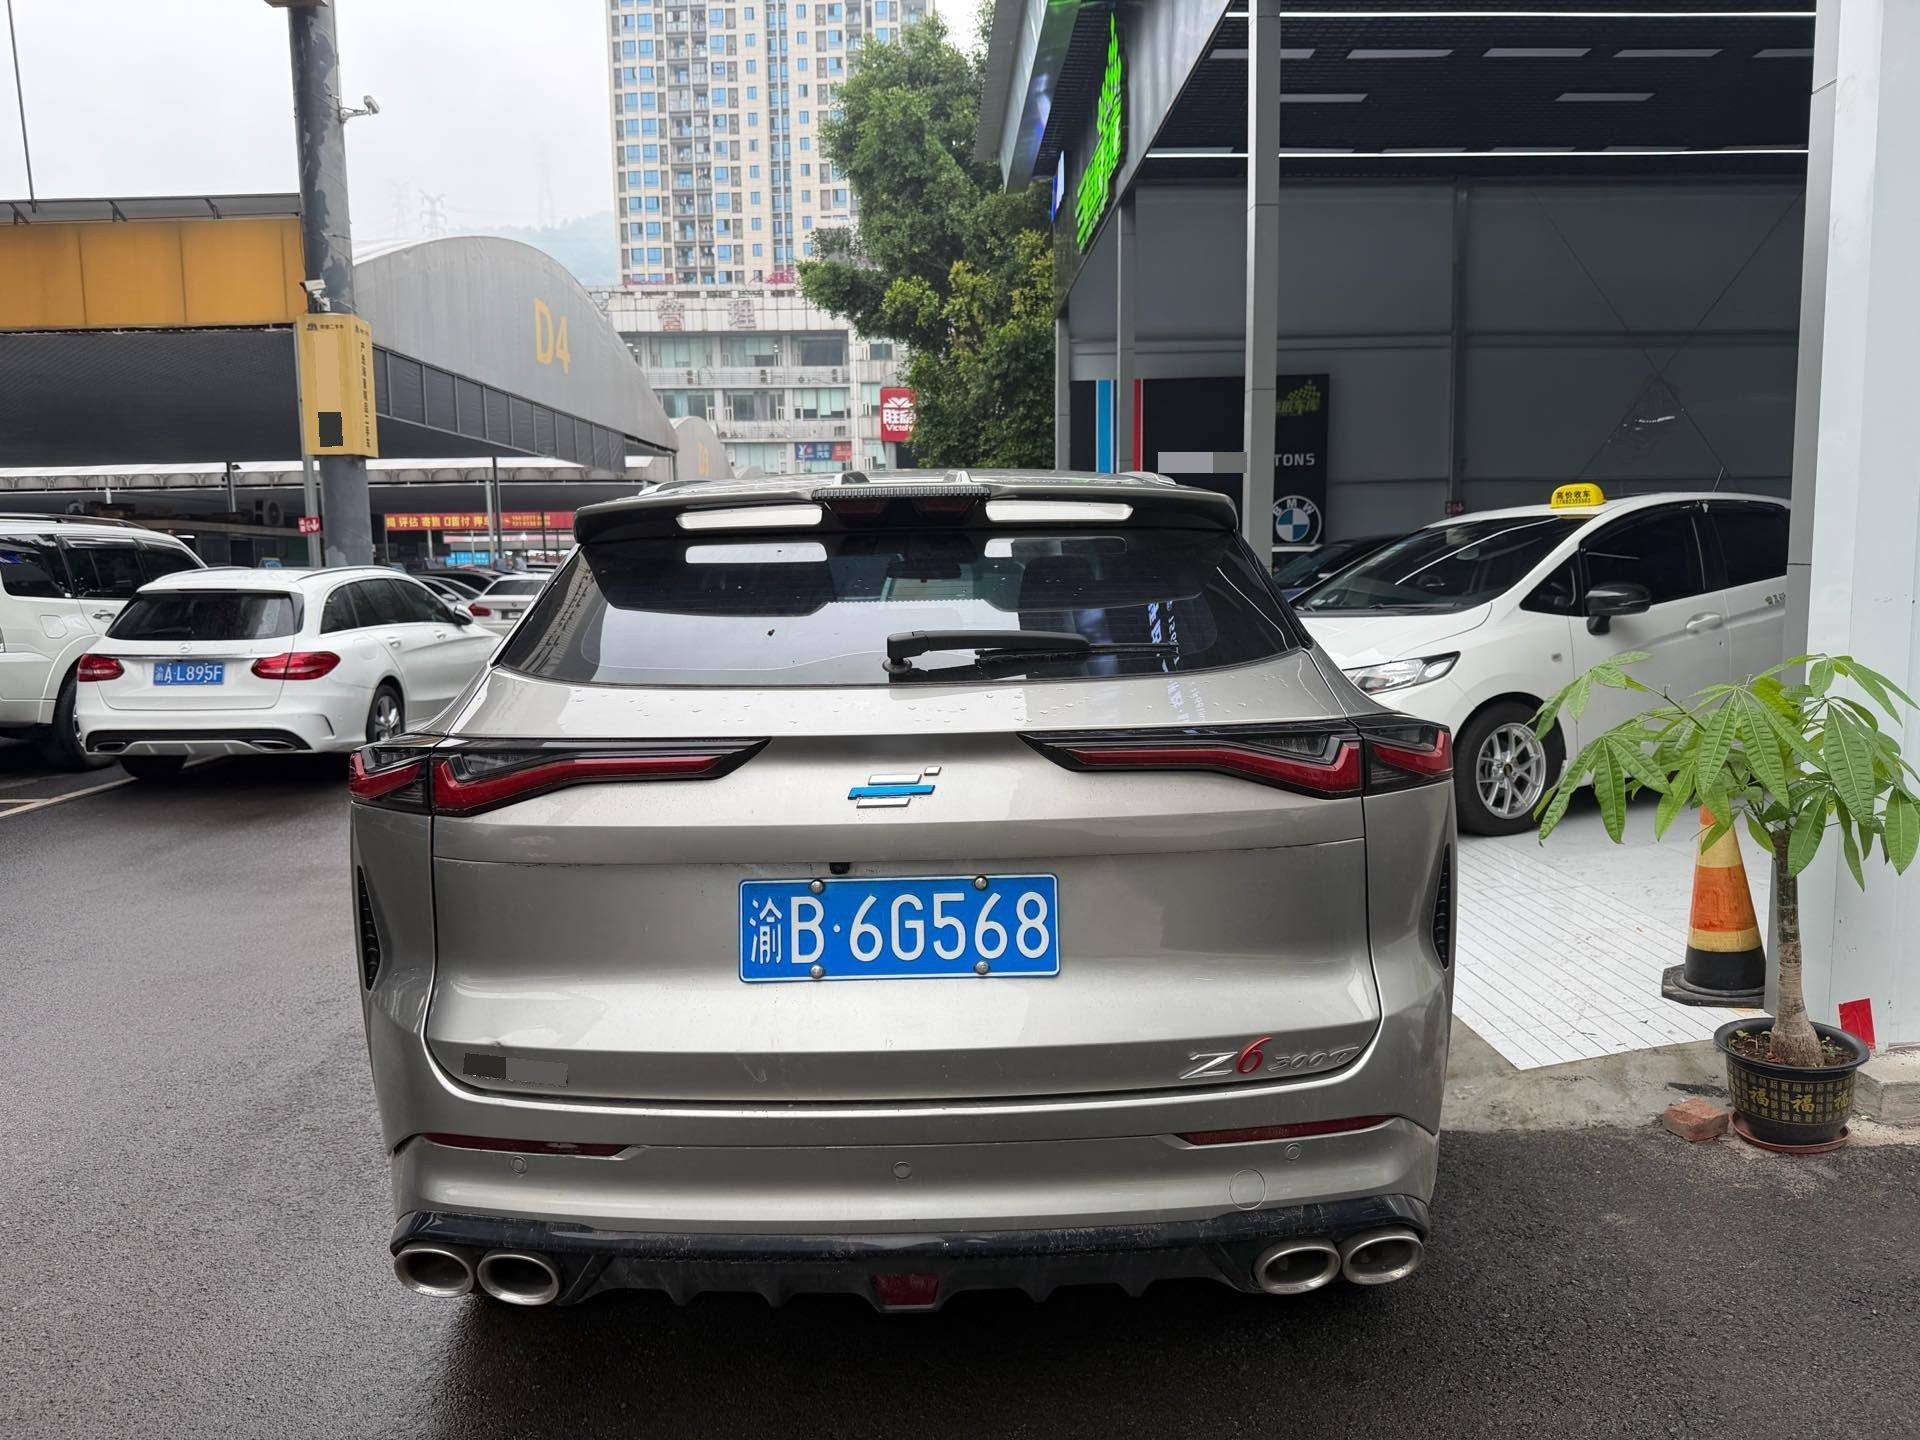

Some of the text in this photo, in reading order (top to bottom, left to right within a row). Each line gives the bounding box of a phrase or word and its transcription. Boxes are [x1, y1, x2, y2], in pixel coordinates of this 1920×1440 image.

[535, 297, 571, 374] D4
[1273, 498, 1316, 517] BMW
[1556, 490, 1592, 500] 高价收车
[749, 891, 1050, 965] 渝B·6G568
[1179, 1034, 1360, 1080] Z6 300T
[1749, 1086, 1770, 1108] 福
[1791, 1094, 1815, 1114] 福
